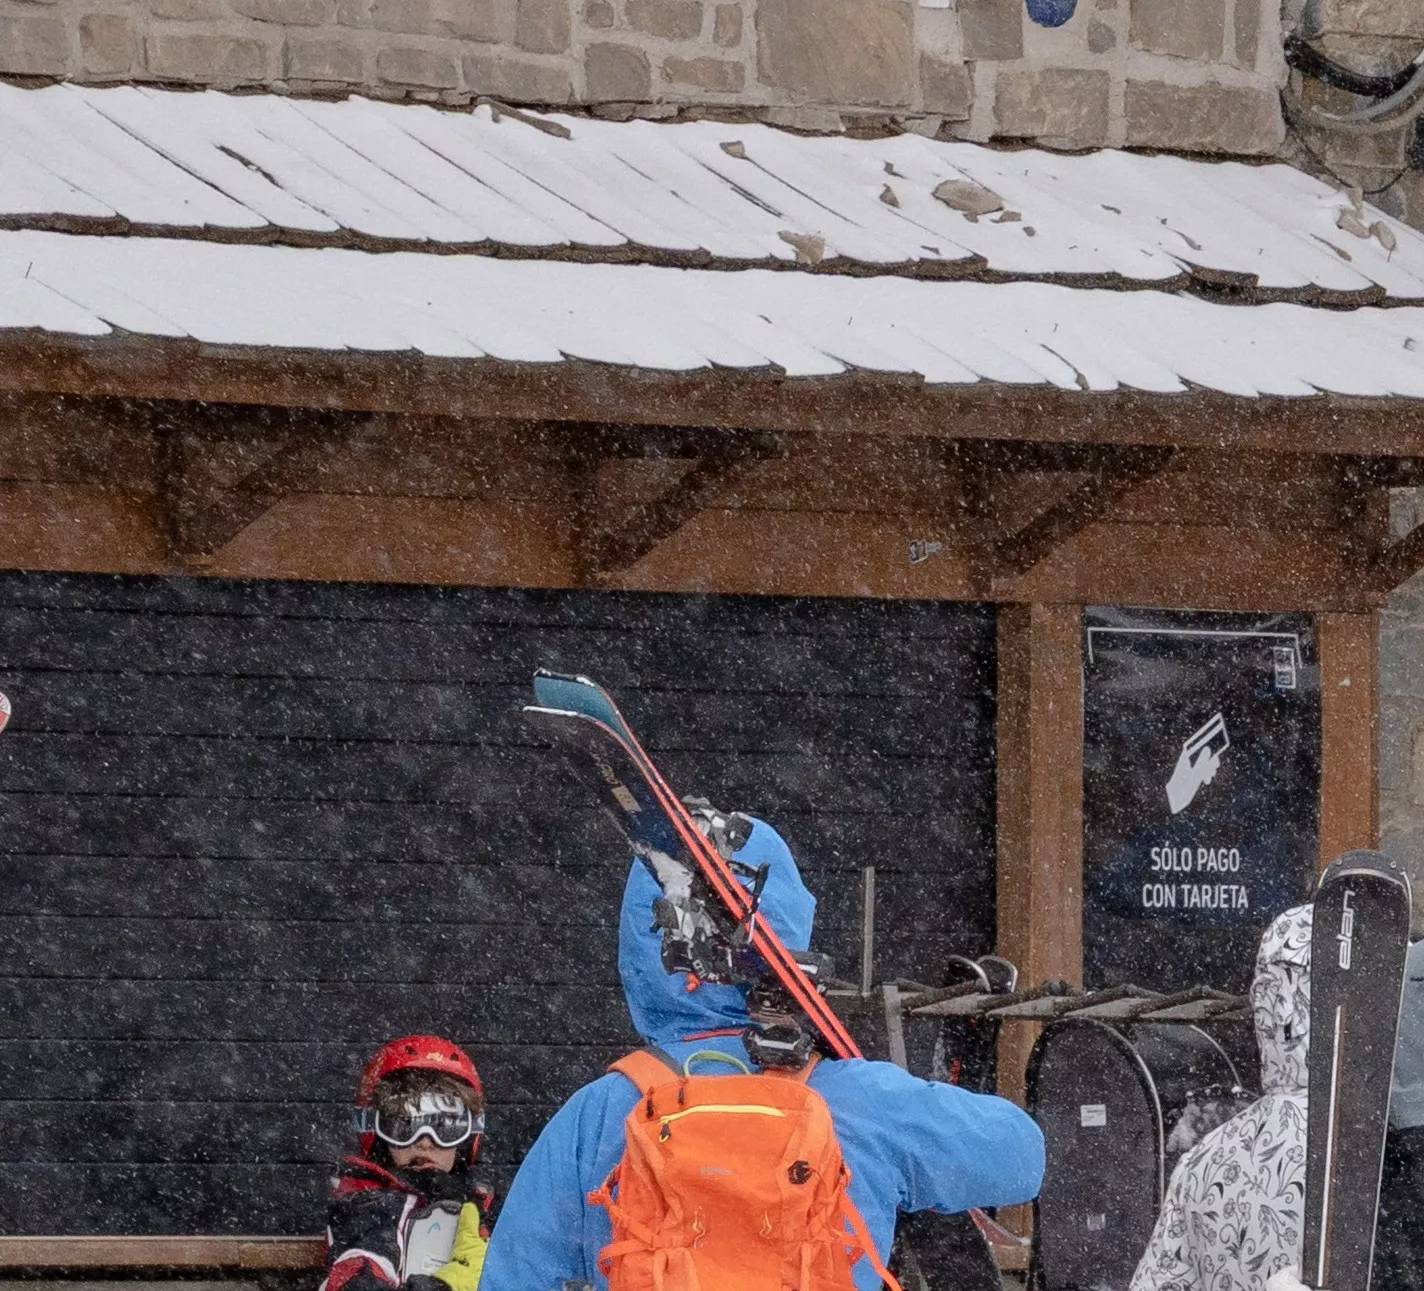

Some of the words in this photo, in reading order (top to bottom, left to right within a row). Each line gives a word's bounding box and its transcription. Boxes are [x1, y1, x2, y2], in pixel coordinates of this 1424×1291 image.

[1151, 841, 1192, 872] SÓLO
[1196, 848, 1240, 872] PAGO
[1142, 884, 1176, 909] CON
[1183, 884, 1249, 909] TARJETA
[1336, 889, 1357, 971] elan
